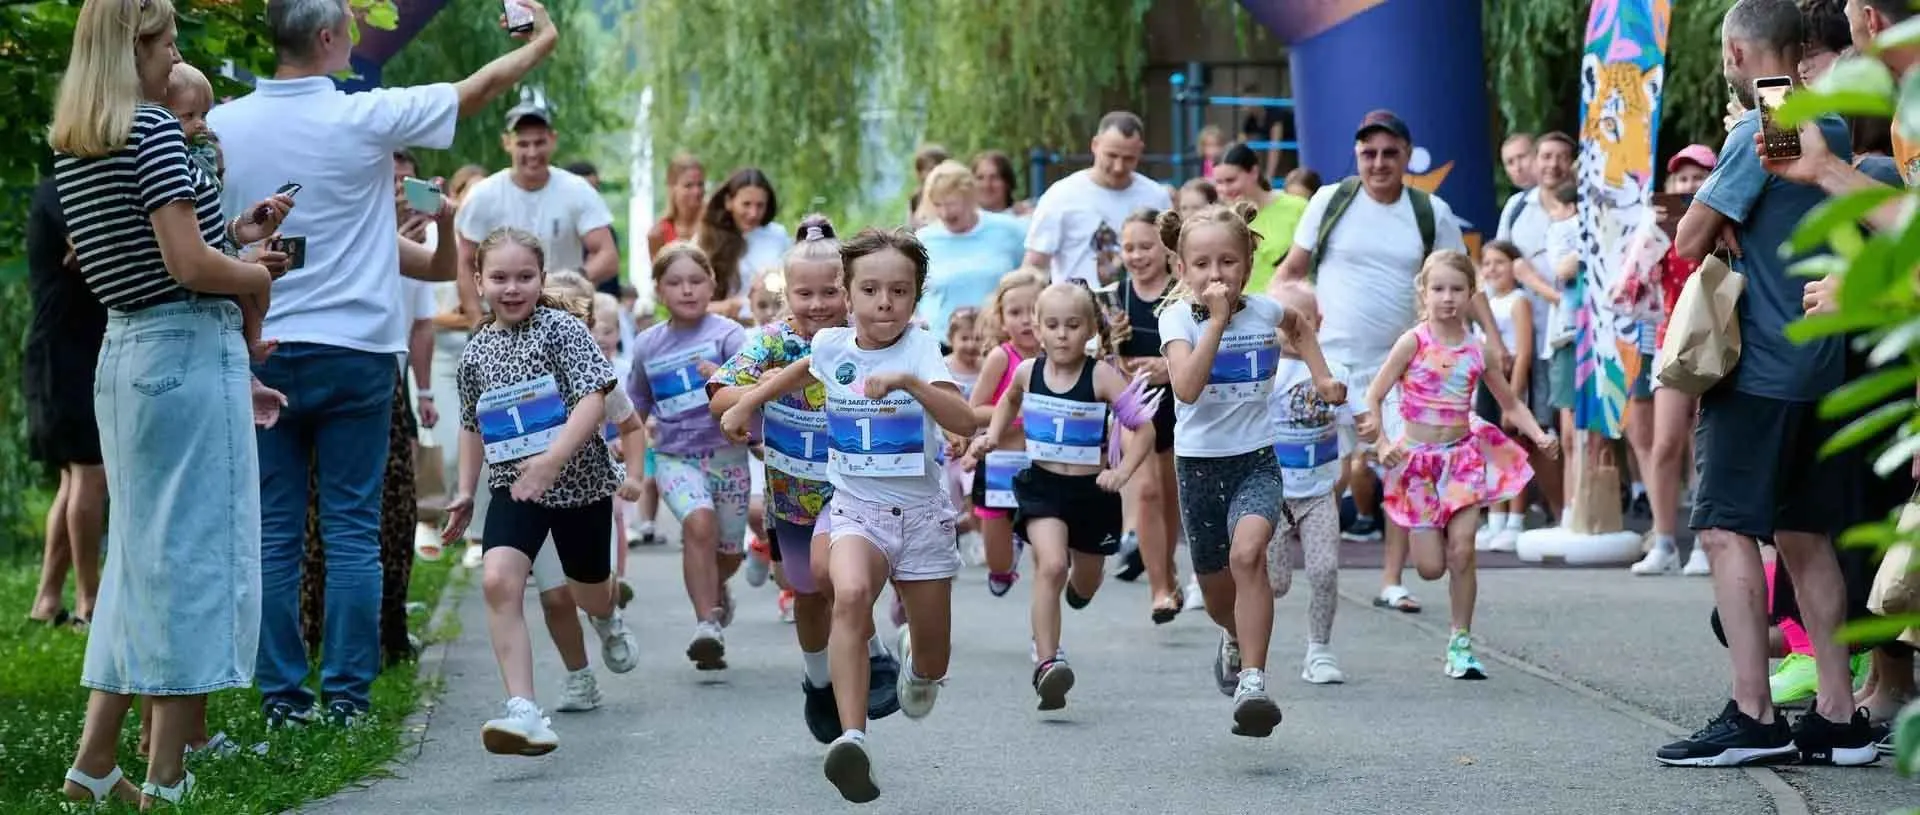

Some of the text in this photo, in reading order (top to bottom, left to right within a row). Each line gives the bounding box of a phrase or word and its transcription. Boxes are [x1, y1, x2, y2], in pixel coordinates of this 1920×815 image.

[1245, 350, 1258, 379] 1
[676, 367, 691, 392] 1
[506, 406, 525, 434] 1
[856, 417, 872, 451] 1
[1052, 417, 1065, 443] 1
[800, 431, 815, 459] 1
[1304, 444, 1316, 468] 1
